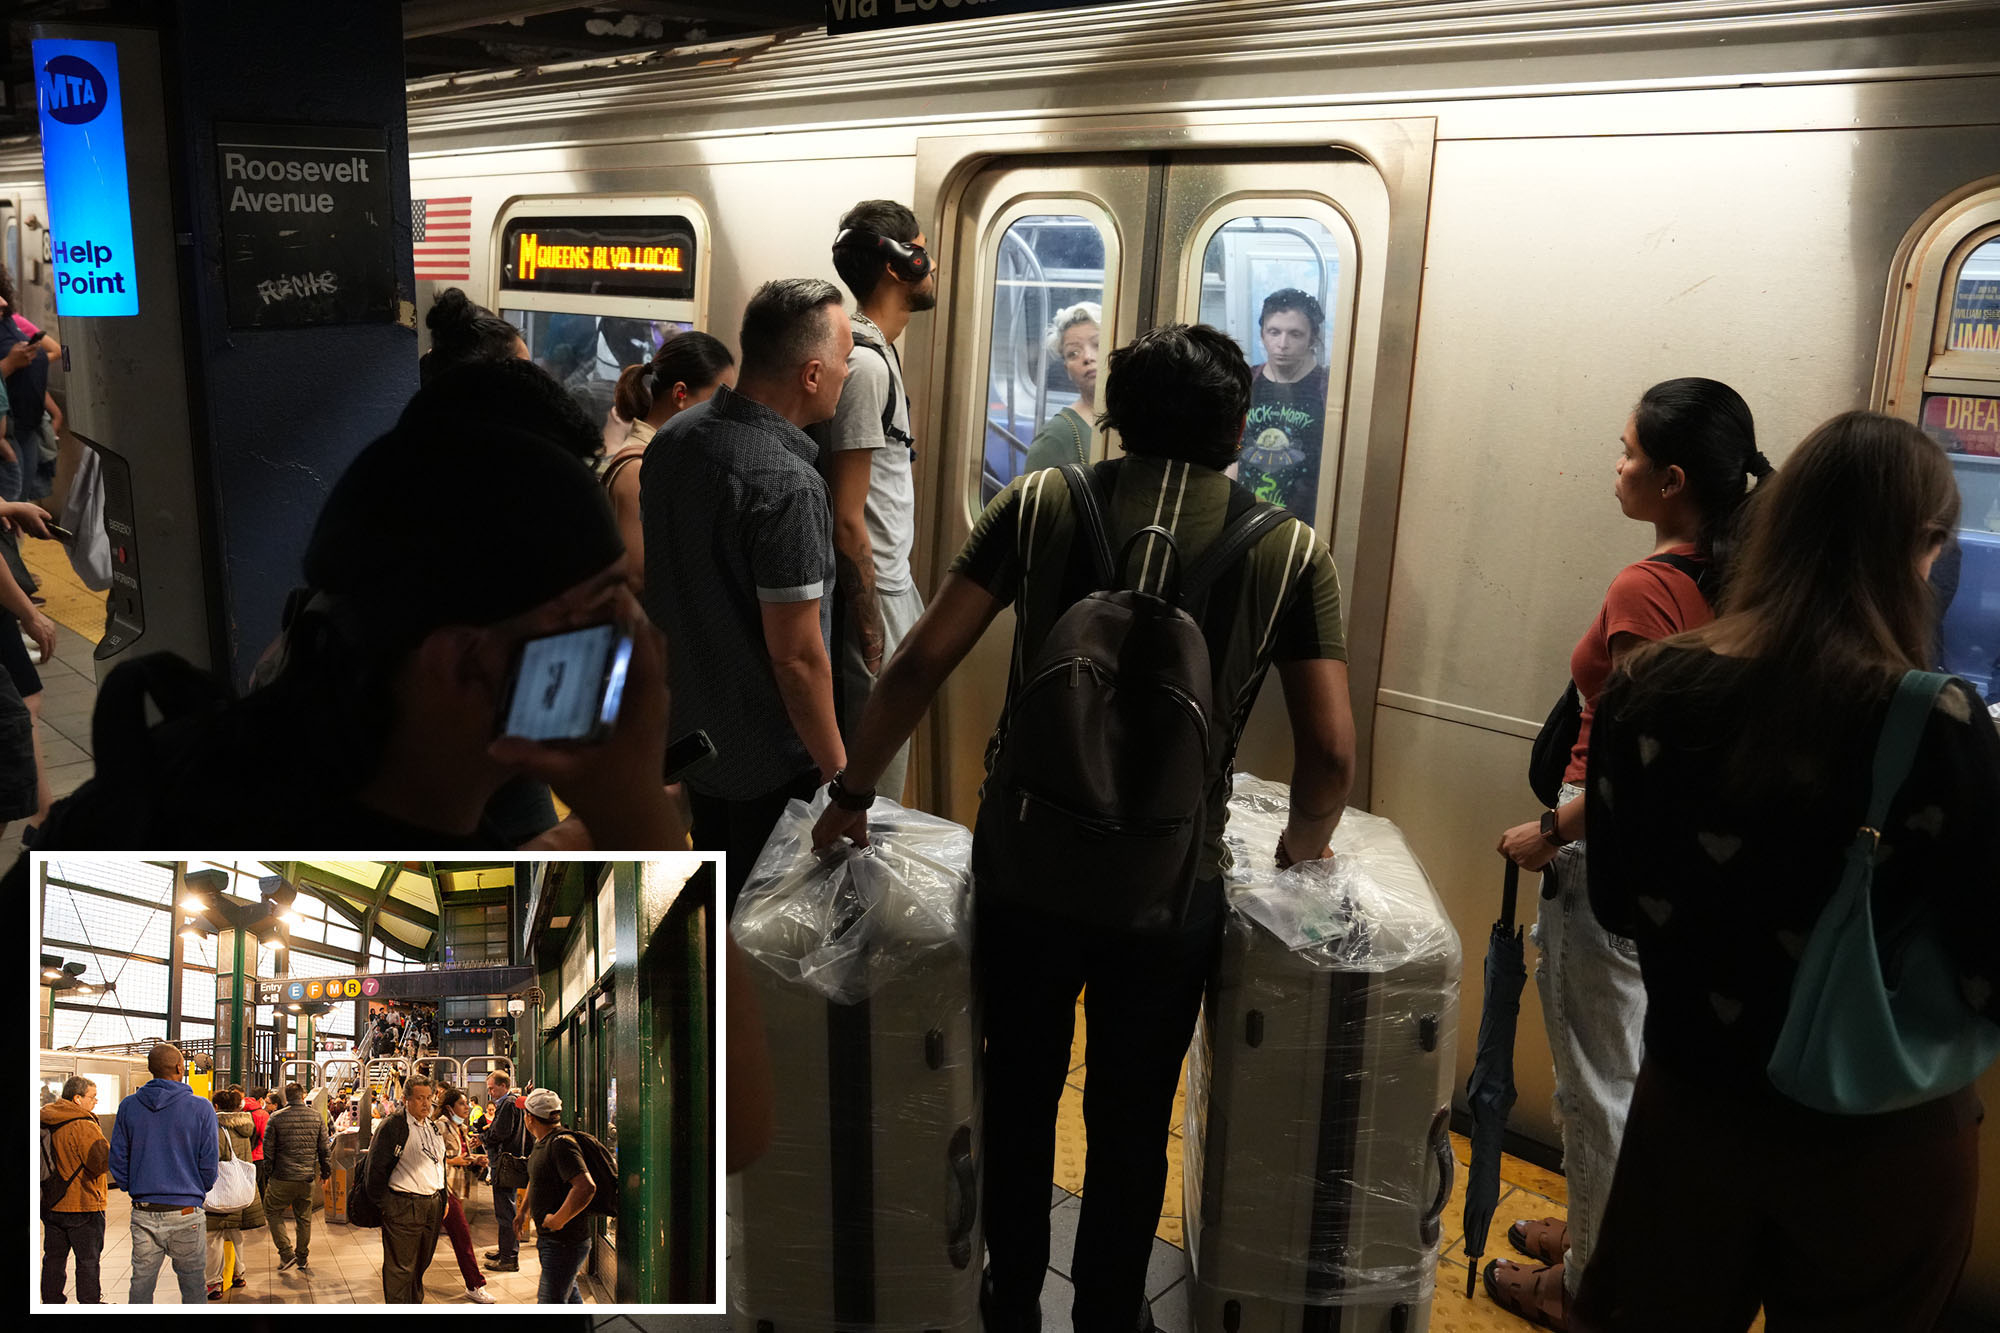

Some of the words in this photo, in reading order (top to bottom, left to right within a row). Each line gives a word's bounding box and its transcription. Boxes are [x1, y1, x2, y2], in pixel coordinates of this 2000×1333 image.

[44, 71, 96, 110] MTA
[224, 152, 370, 183] Roosevelt
[229, 186, 335, 213] Avenue
[53, 240, 112, 268] Help
[519, 233, 537, 279] M
[537, 245, 590, 269] QUEENS
[592, 246, 631, 270] BLVD
[634, 247, 682, 271] LOCAL
[57, 271, 125, 294] Point
[1280, 405, 1315, 429] MORTY
[1945, 397, 2000, 432] DREA
[260, 983, 282, 993] Entry
[329, 983, 339, 994] M
